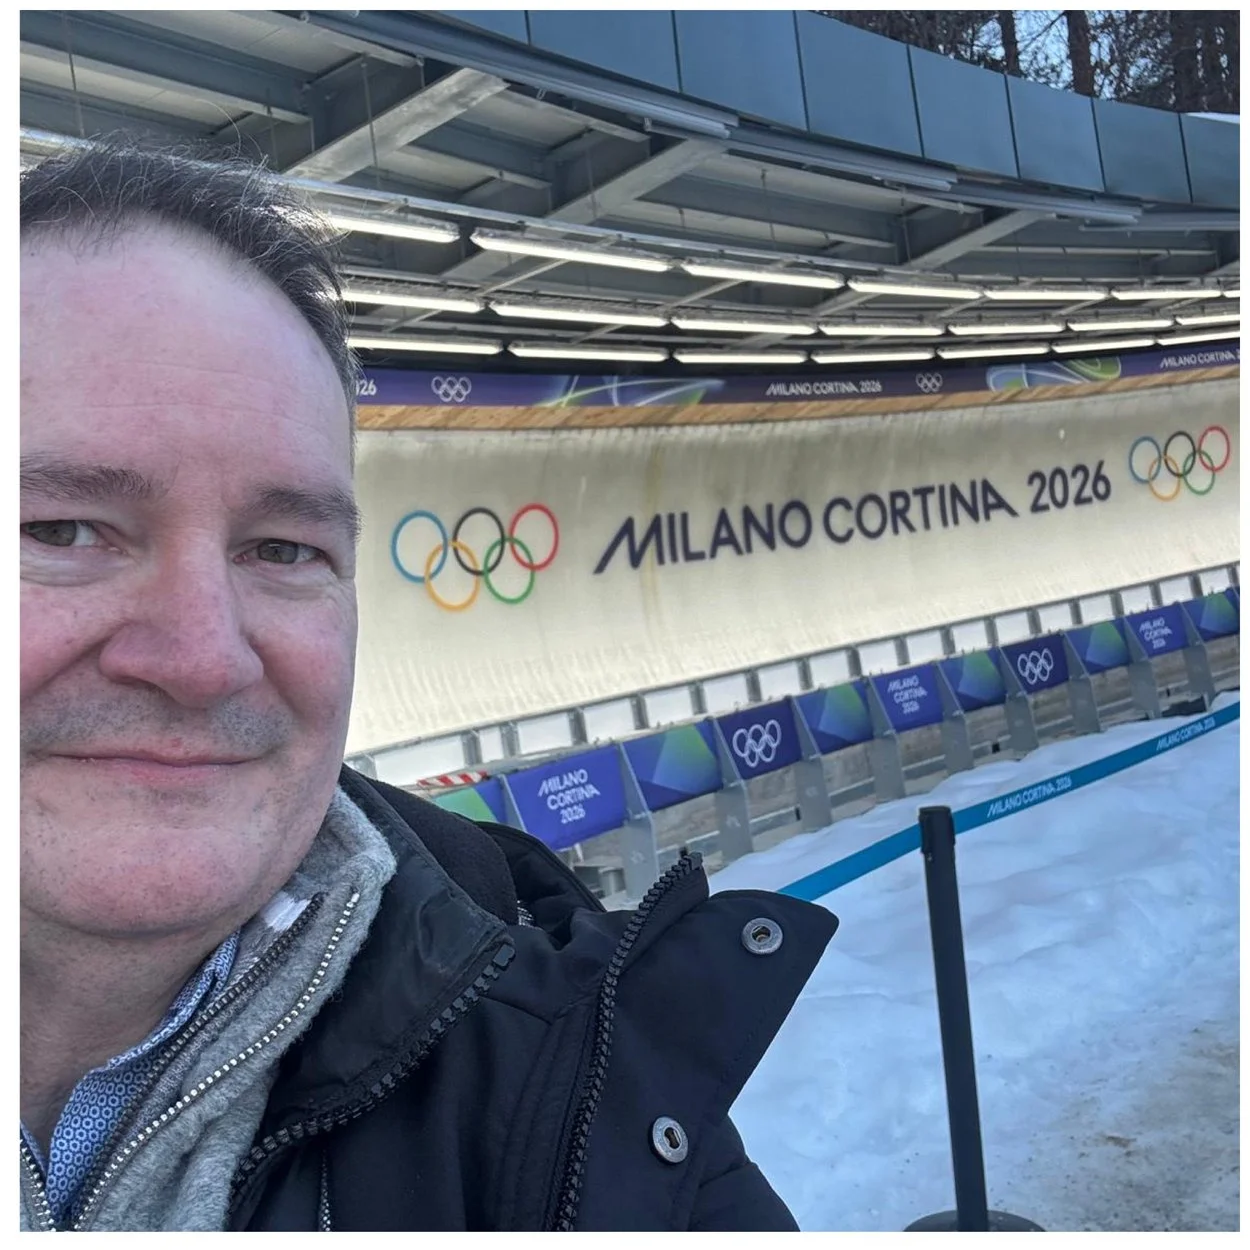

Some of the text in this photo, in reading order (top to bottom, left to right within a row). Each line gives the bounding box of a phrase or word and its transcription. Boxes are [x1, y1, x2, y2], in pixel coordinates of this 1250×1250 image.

[1160, 354, 1197, 368] MILANO
[1197, 351, 1236, 364] CORTINA
[765, 379, 882, 396] MILANO CORTINA 2026
[593, 461, 1112, 575] MILANO CORTINA 2026
[537, 769, 588, 797] MILANO
[547, 784, 601, 810] CORTINA
[987, 792, 1021, 818] MILANO
[1022, 782, 1056, 804] CORTINA
[560, 803, 586, 824] 2026
